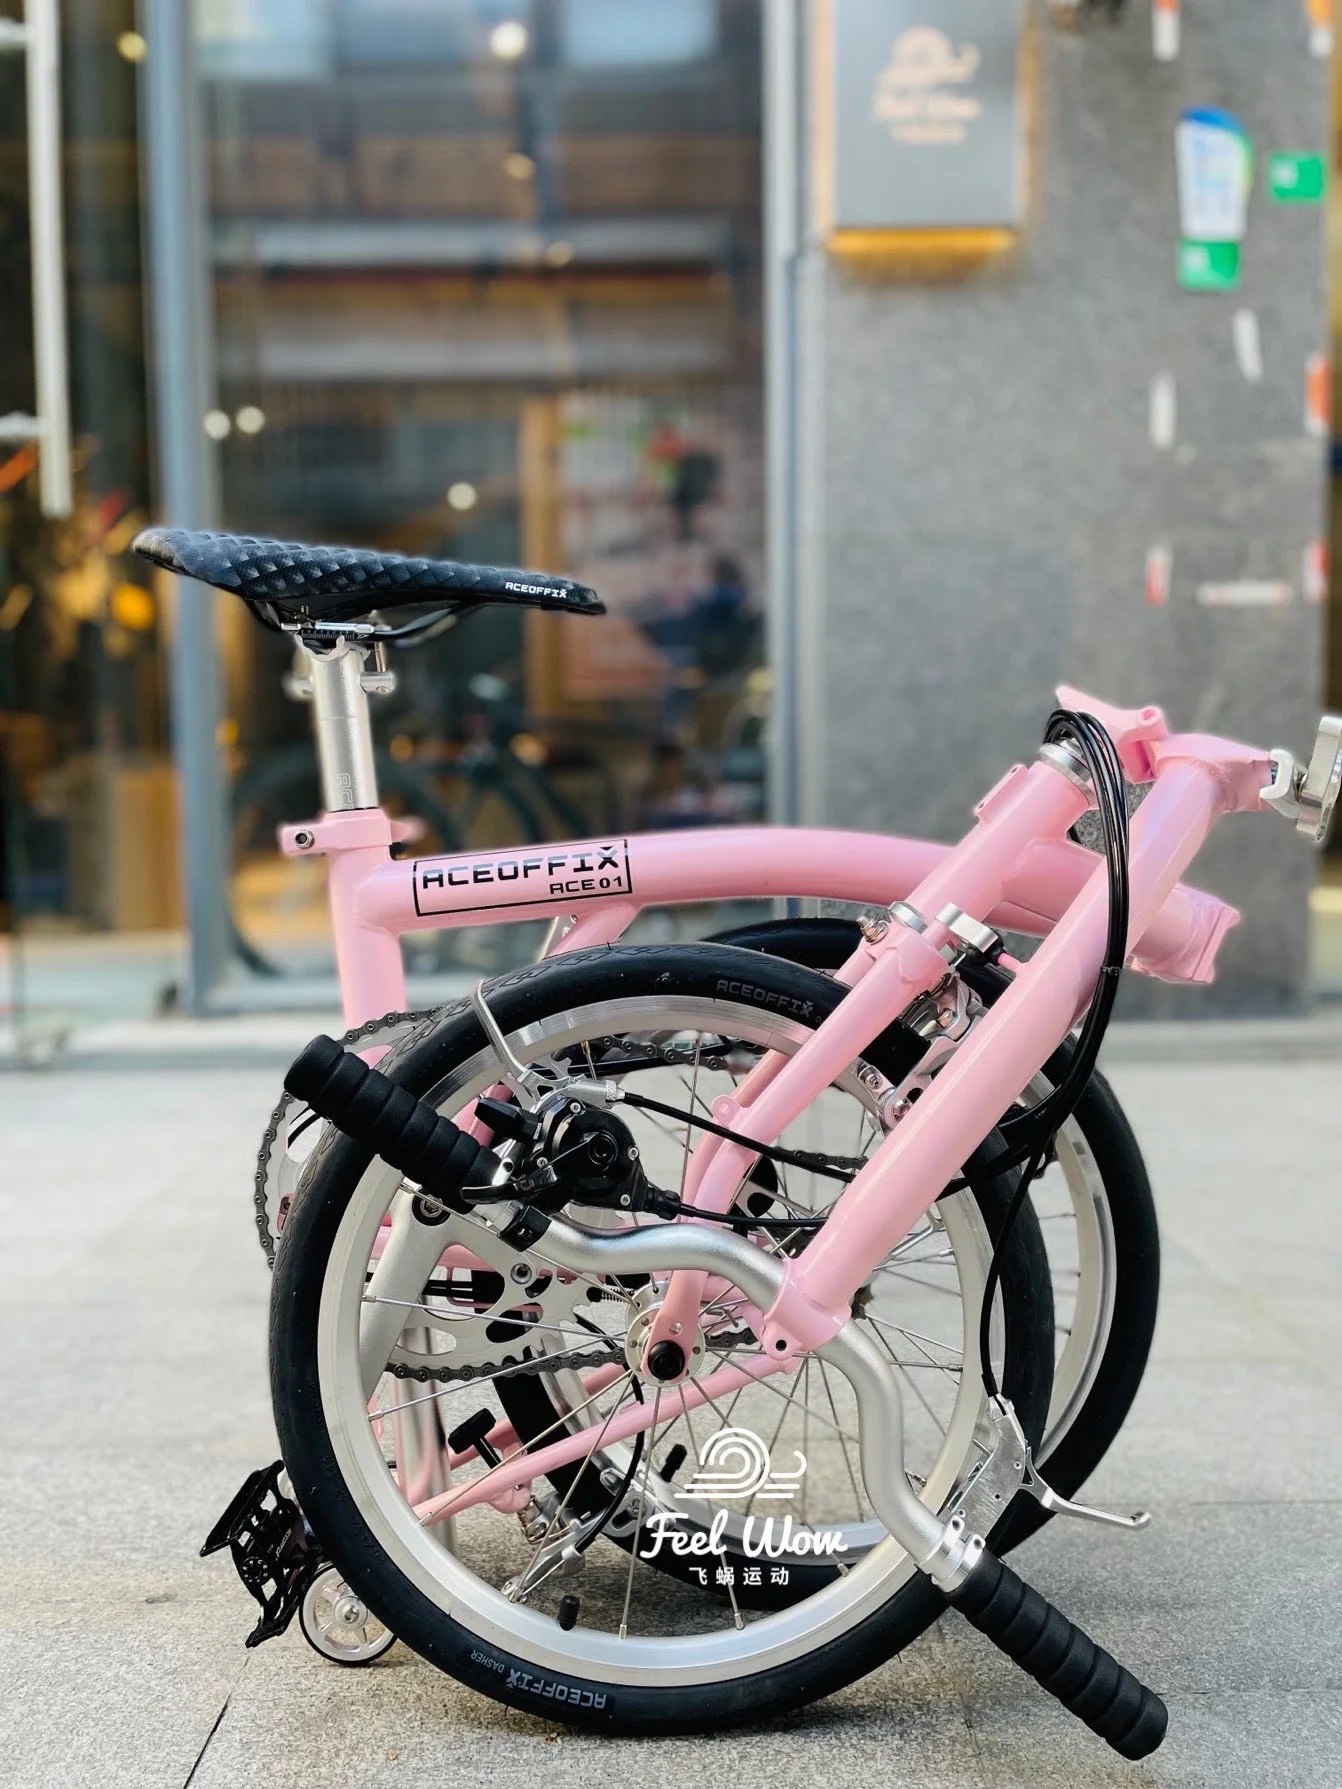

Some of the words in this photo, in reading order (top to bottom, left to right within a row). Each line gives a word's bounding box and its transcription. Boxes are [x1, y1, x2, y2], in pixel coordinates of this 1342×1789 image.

[505, 581, 567, 598] ACEOFFIX
[422, 846, 619, 889] ACEOFFIX
[716, 979, 814, 1018] ACEOFFIX
[470, 1649, 505, 1674] DASHER
[506, 1668, 607, 1709] ACEOFFIX
